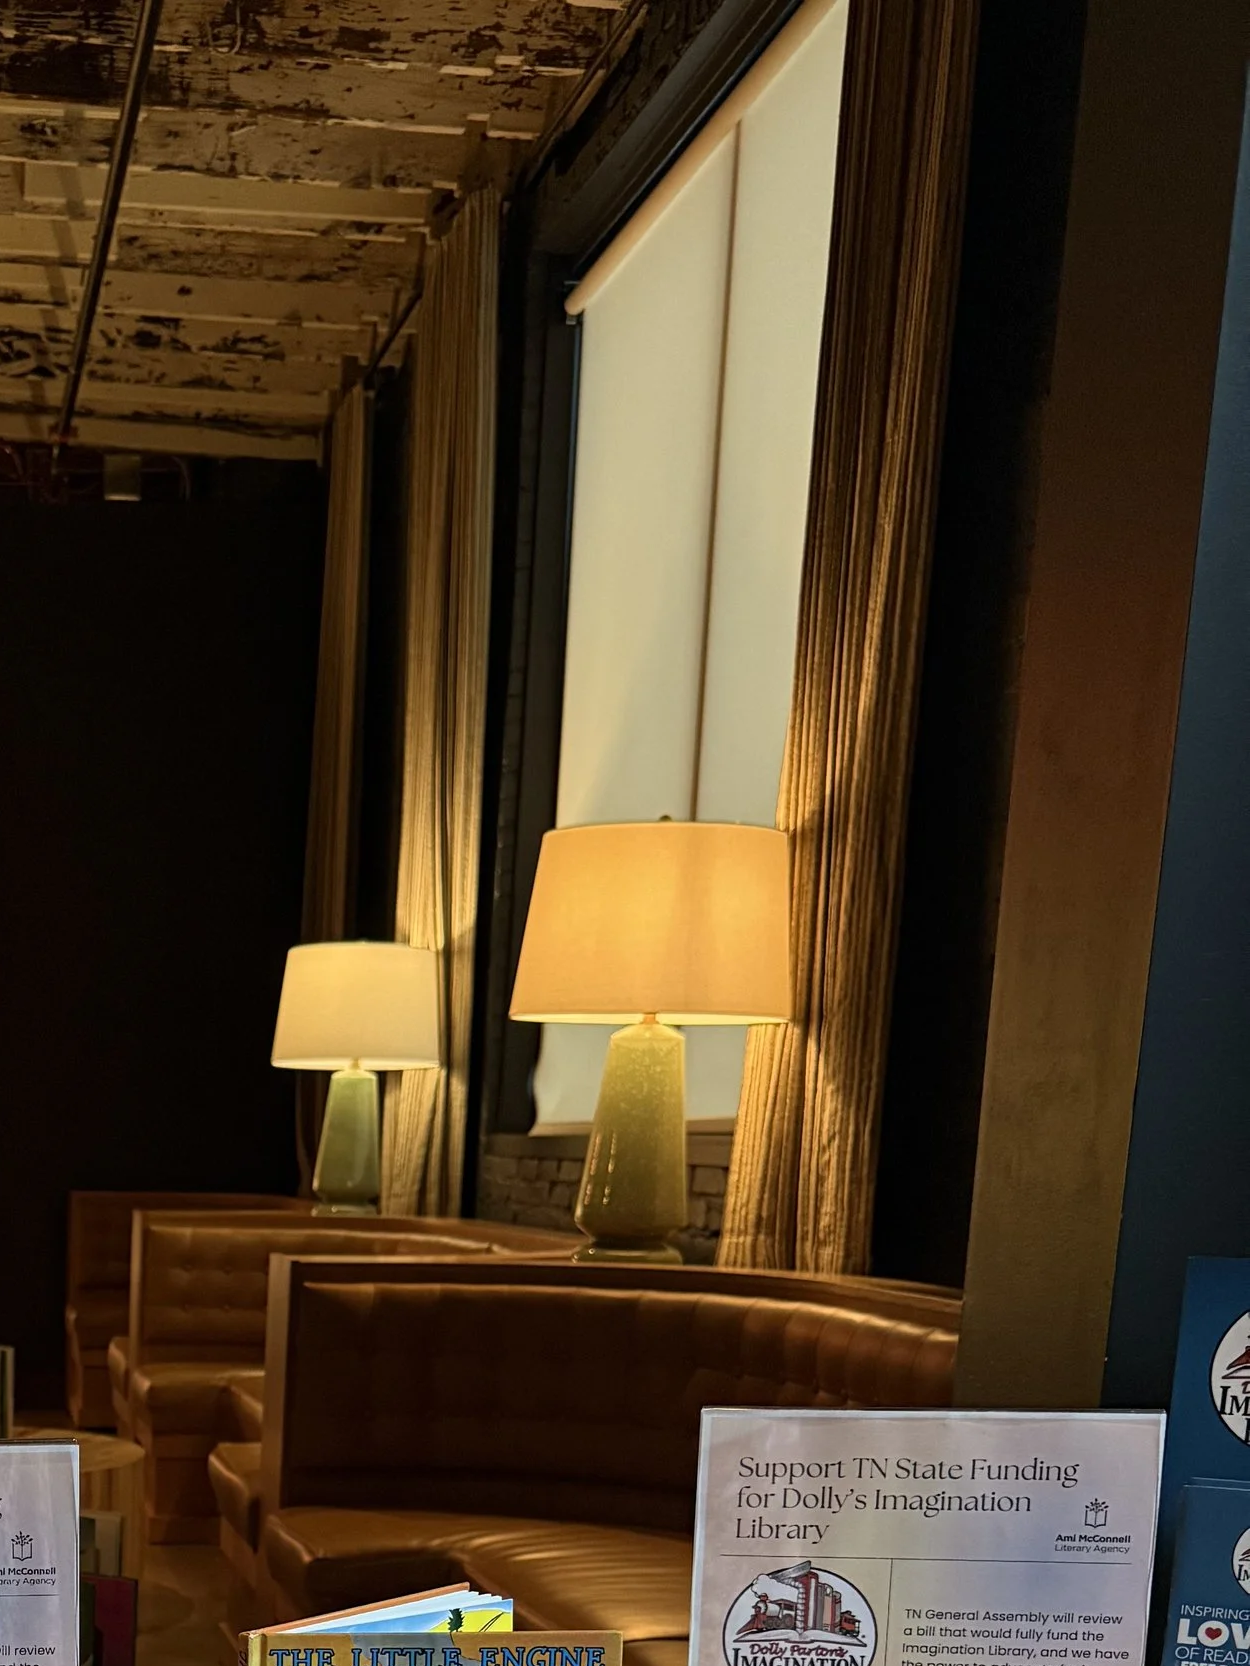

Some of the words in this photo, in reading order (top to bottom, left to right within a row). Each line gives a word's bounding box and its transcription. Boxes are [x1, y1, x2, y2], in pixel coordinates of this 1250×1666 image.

[1180, 1604, 1250, 1620] INSPIRING
[14, 1644, 55, 1656] review
[1175, 1646, 1200, 1659] OF
[1203, 1648, 1250, 1665] READ
